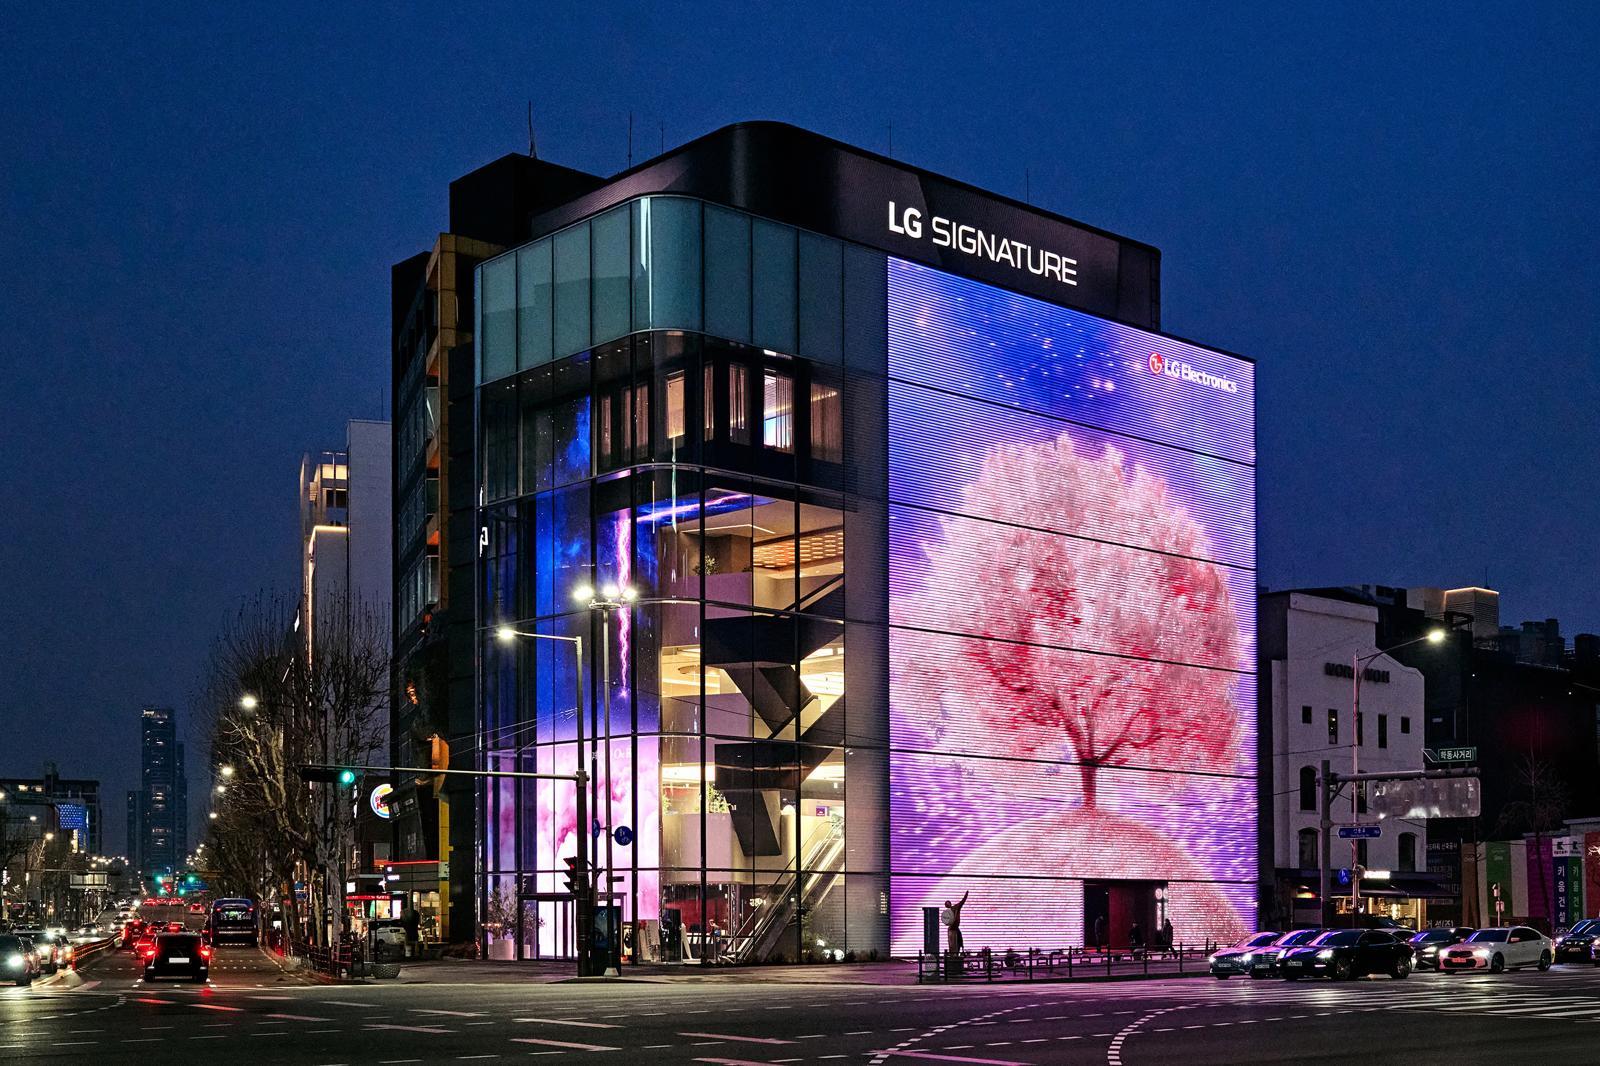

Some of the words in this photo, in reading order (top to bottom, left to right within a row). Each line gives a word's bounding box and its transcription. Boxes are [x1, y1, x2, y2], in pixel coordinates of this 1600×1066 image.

[888, 201, 922, 239] LG
[932, 216, 1077, 286] SIGNATURE
[1164, 359, 1180, 378] LG
[1181, 362, 1237, 392] Electronics
[1440, 749, 1472, 760] 학동사거리
